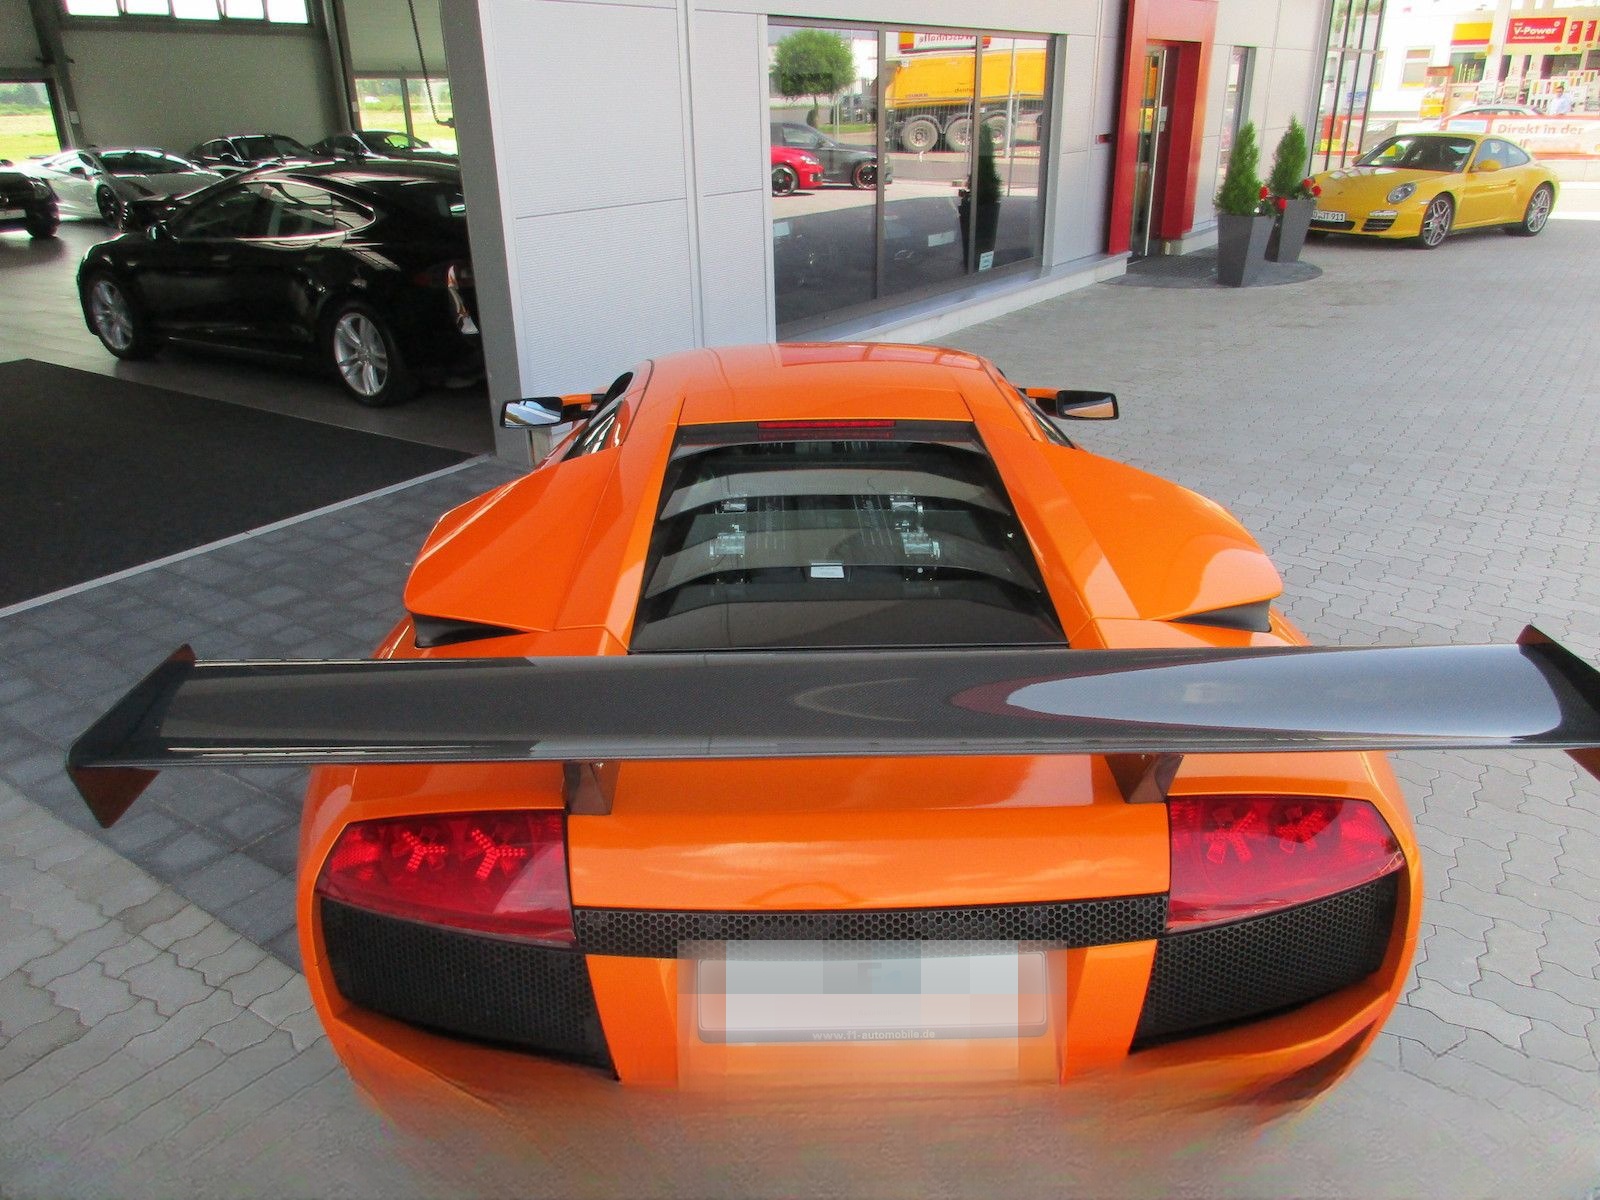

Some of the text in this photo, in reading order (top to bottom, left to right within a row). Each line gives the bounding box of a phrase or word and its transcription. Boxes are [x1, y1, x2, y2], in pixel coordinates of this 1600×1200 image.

[1513, 26, 1557, 35] V-Power
[1497, 124, 1585, 136] Direkt in der
[813, 1029, 935, 1041] www.f1-automobile.de
